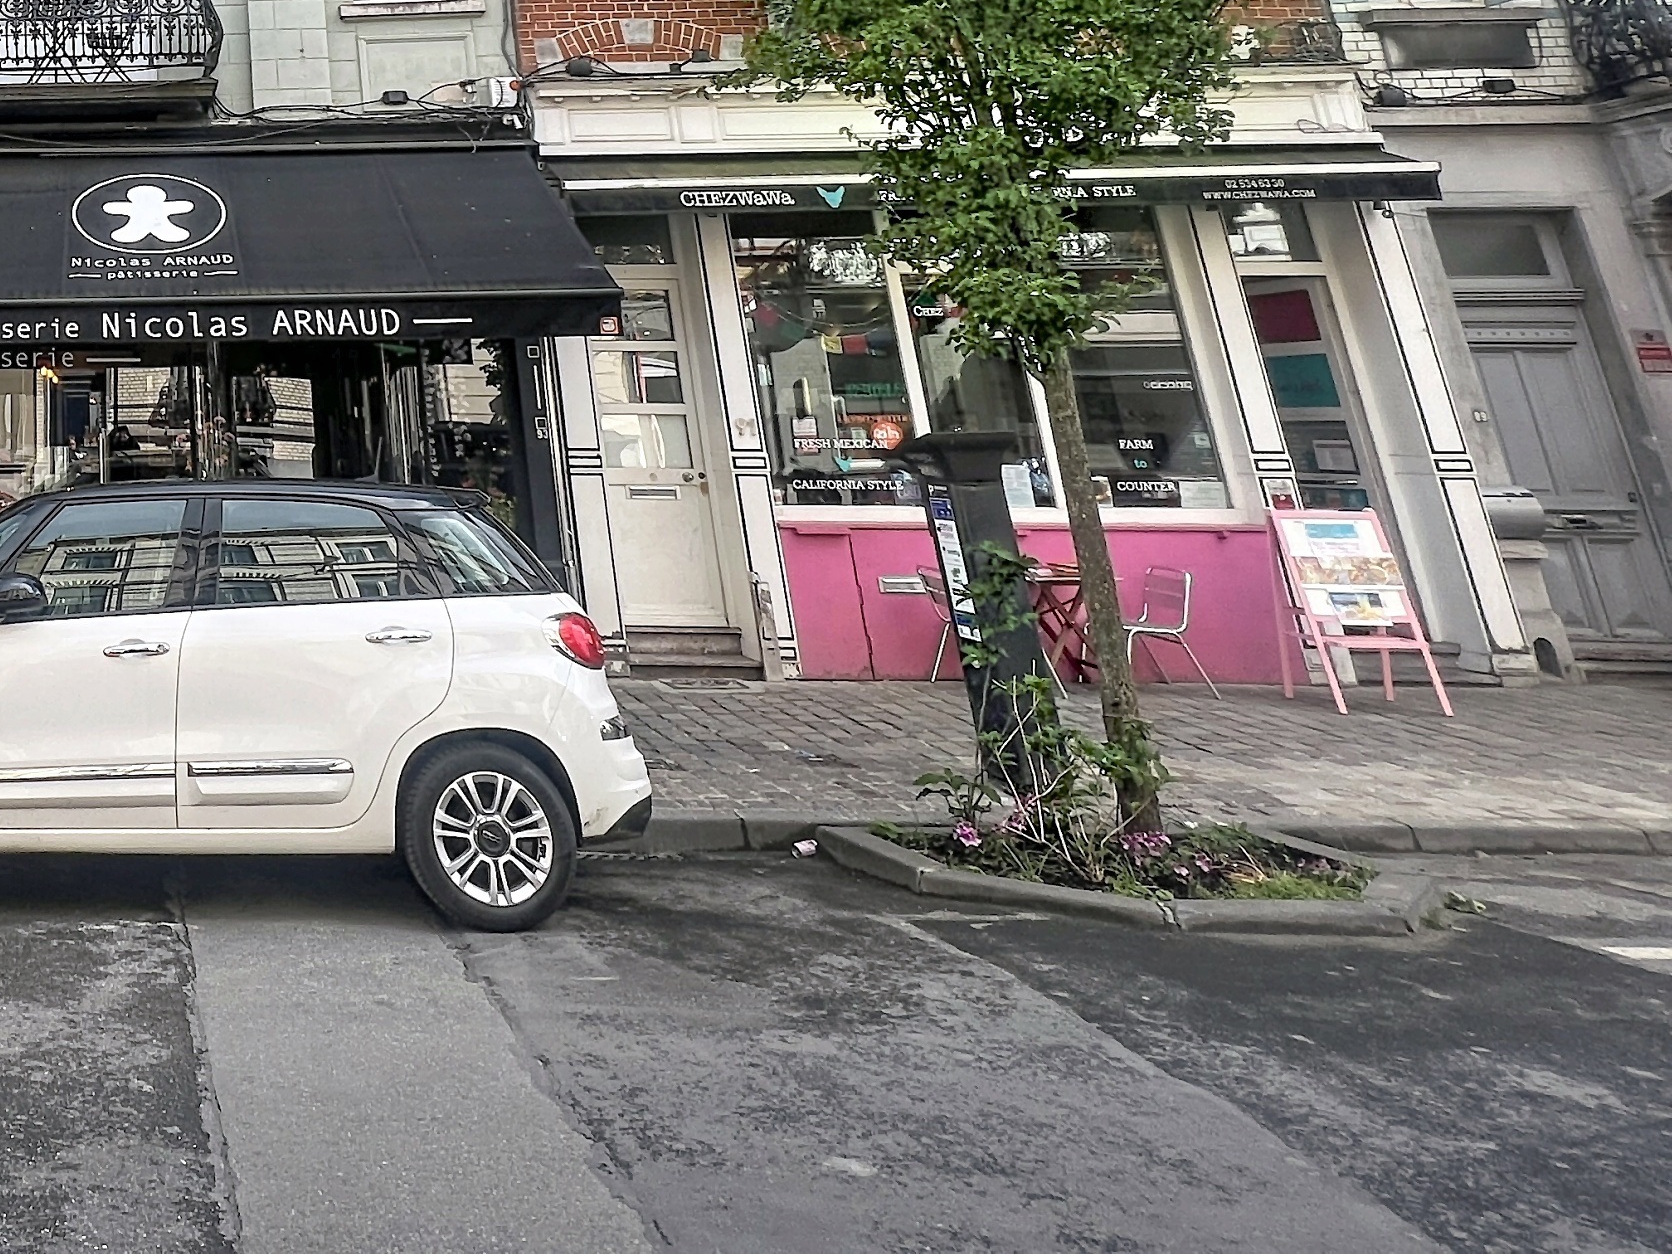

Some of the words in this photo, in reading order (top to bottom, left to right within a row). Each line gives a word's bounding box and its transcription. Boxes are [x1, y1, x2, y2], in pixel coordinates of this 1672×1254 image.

[1091, 185, 1137, 197] STYLE
[71, 257, 152, 267] Nicolas
[163, 254, 234, 266] ARNAUD
[101, 312, 248, 338] Nicolas
[272, 308, 401, 336] ARNAUD
[793, 438, 831, 449] FRESH
[832, 438, 888, 449] MEXICAN
[1118, 439, 1154, 450] FARM
[792, 479, 866, 490] CALIFORNIA
[866, 480, 905, 491] STYLE
[1116, 481, 1177, 492] COUNTER
